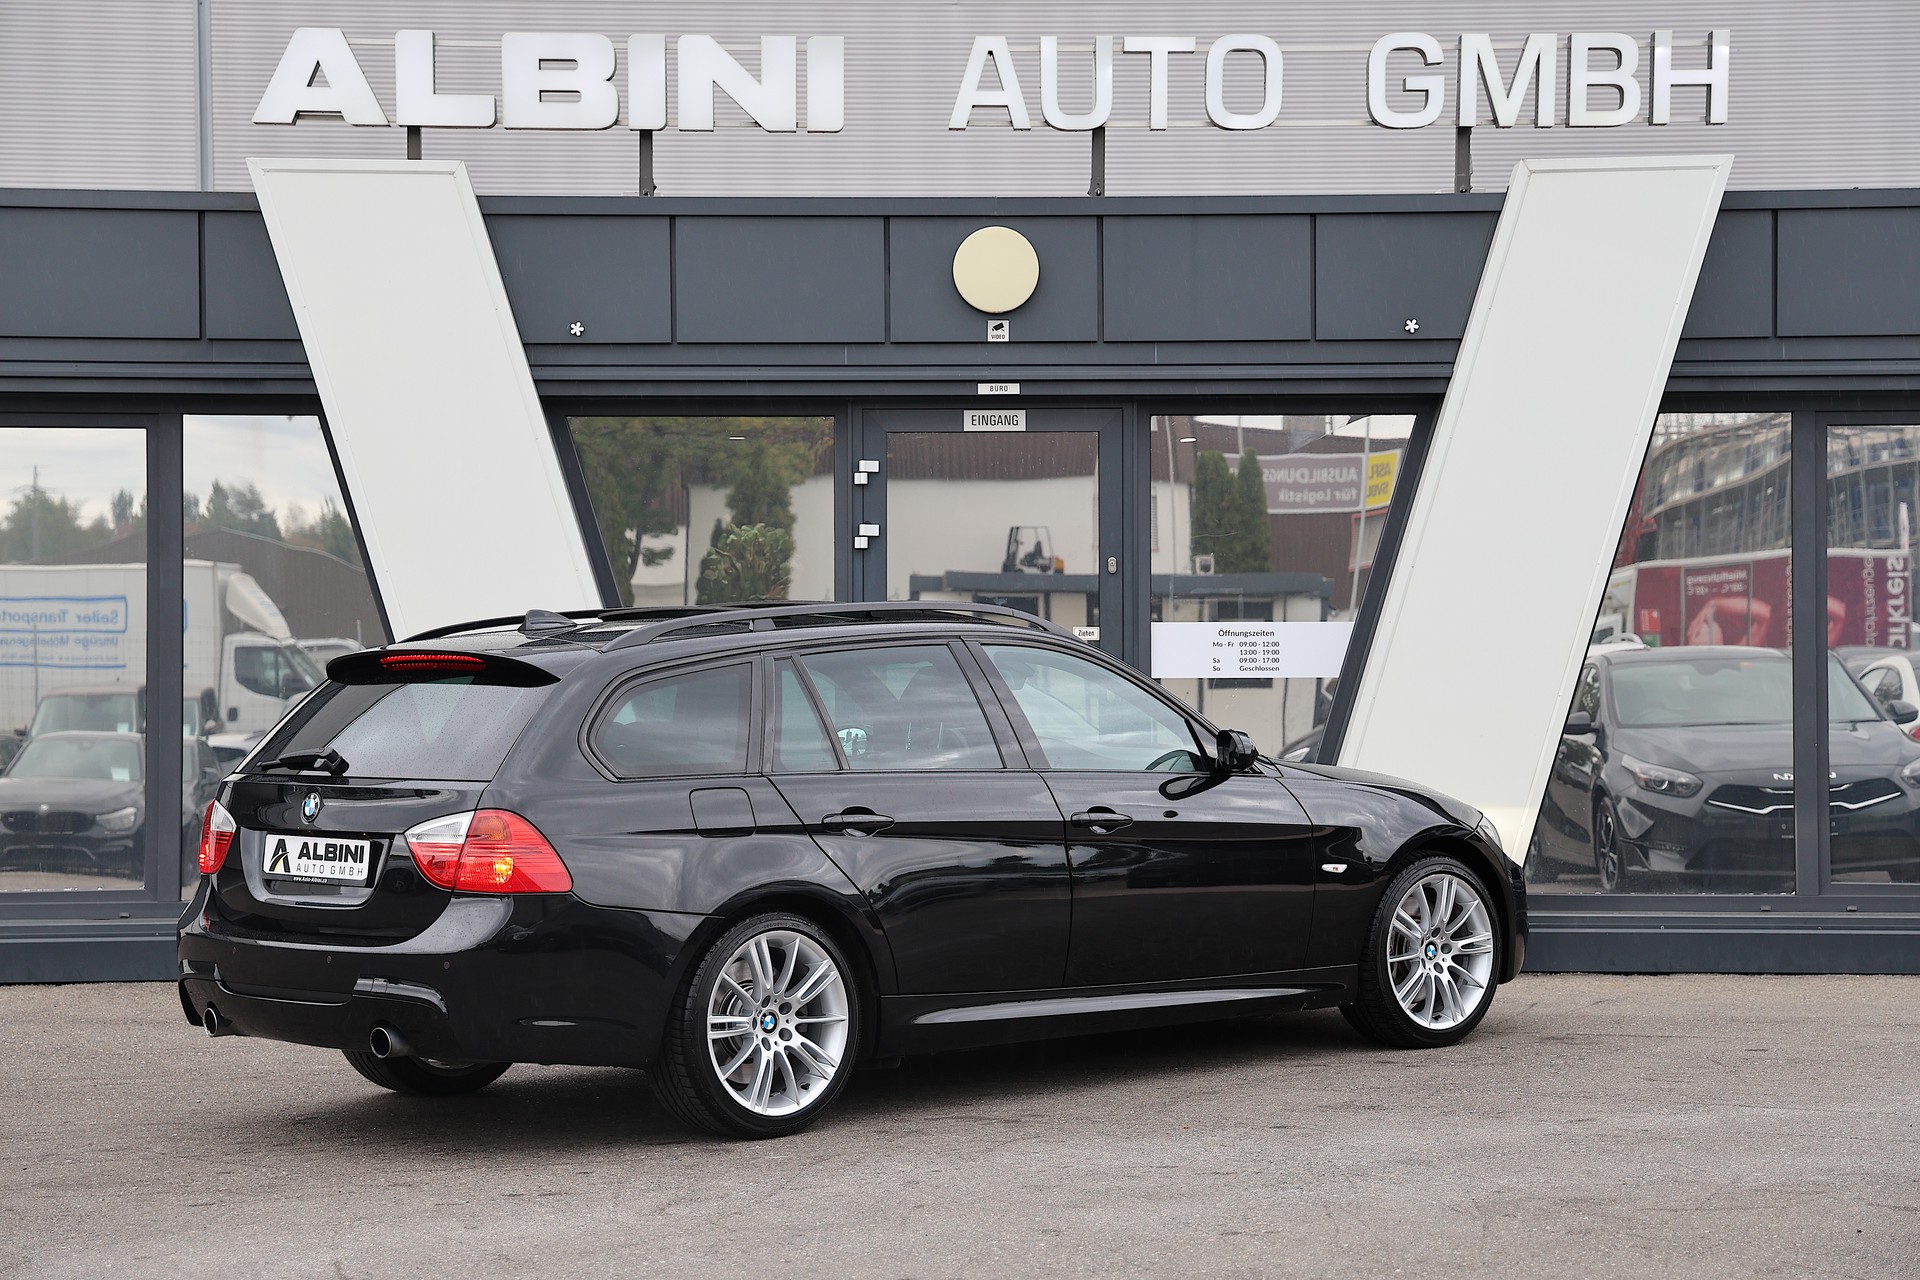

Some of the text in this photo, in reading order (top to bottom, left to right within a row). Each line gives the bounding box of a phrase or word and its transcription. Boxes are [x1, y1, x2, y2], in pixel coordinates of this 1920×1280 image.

[252, 27, 1732, 133] ALBINI AUTO GMBH
[989, 384, 1009, 392] BÜRO
[971, 414, 1019, 427] EINGANG
[1218, 629, 1275, 638] Öffnungszeiten
[297, 842, 365, 864] ALBINI
[296, 863, 364, 877] AUTO GMBH
